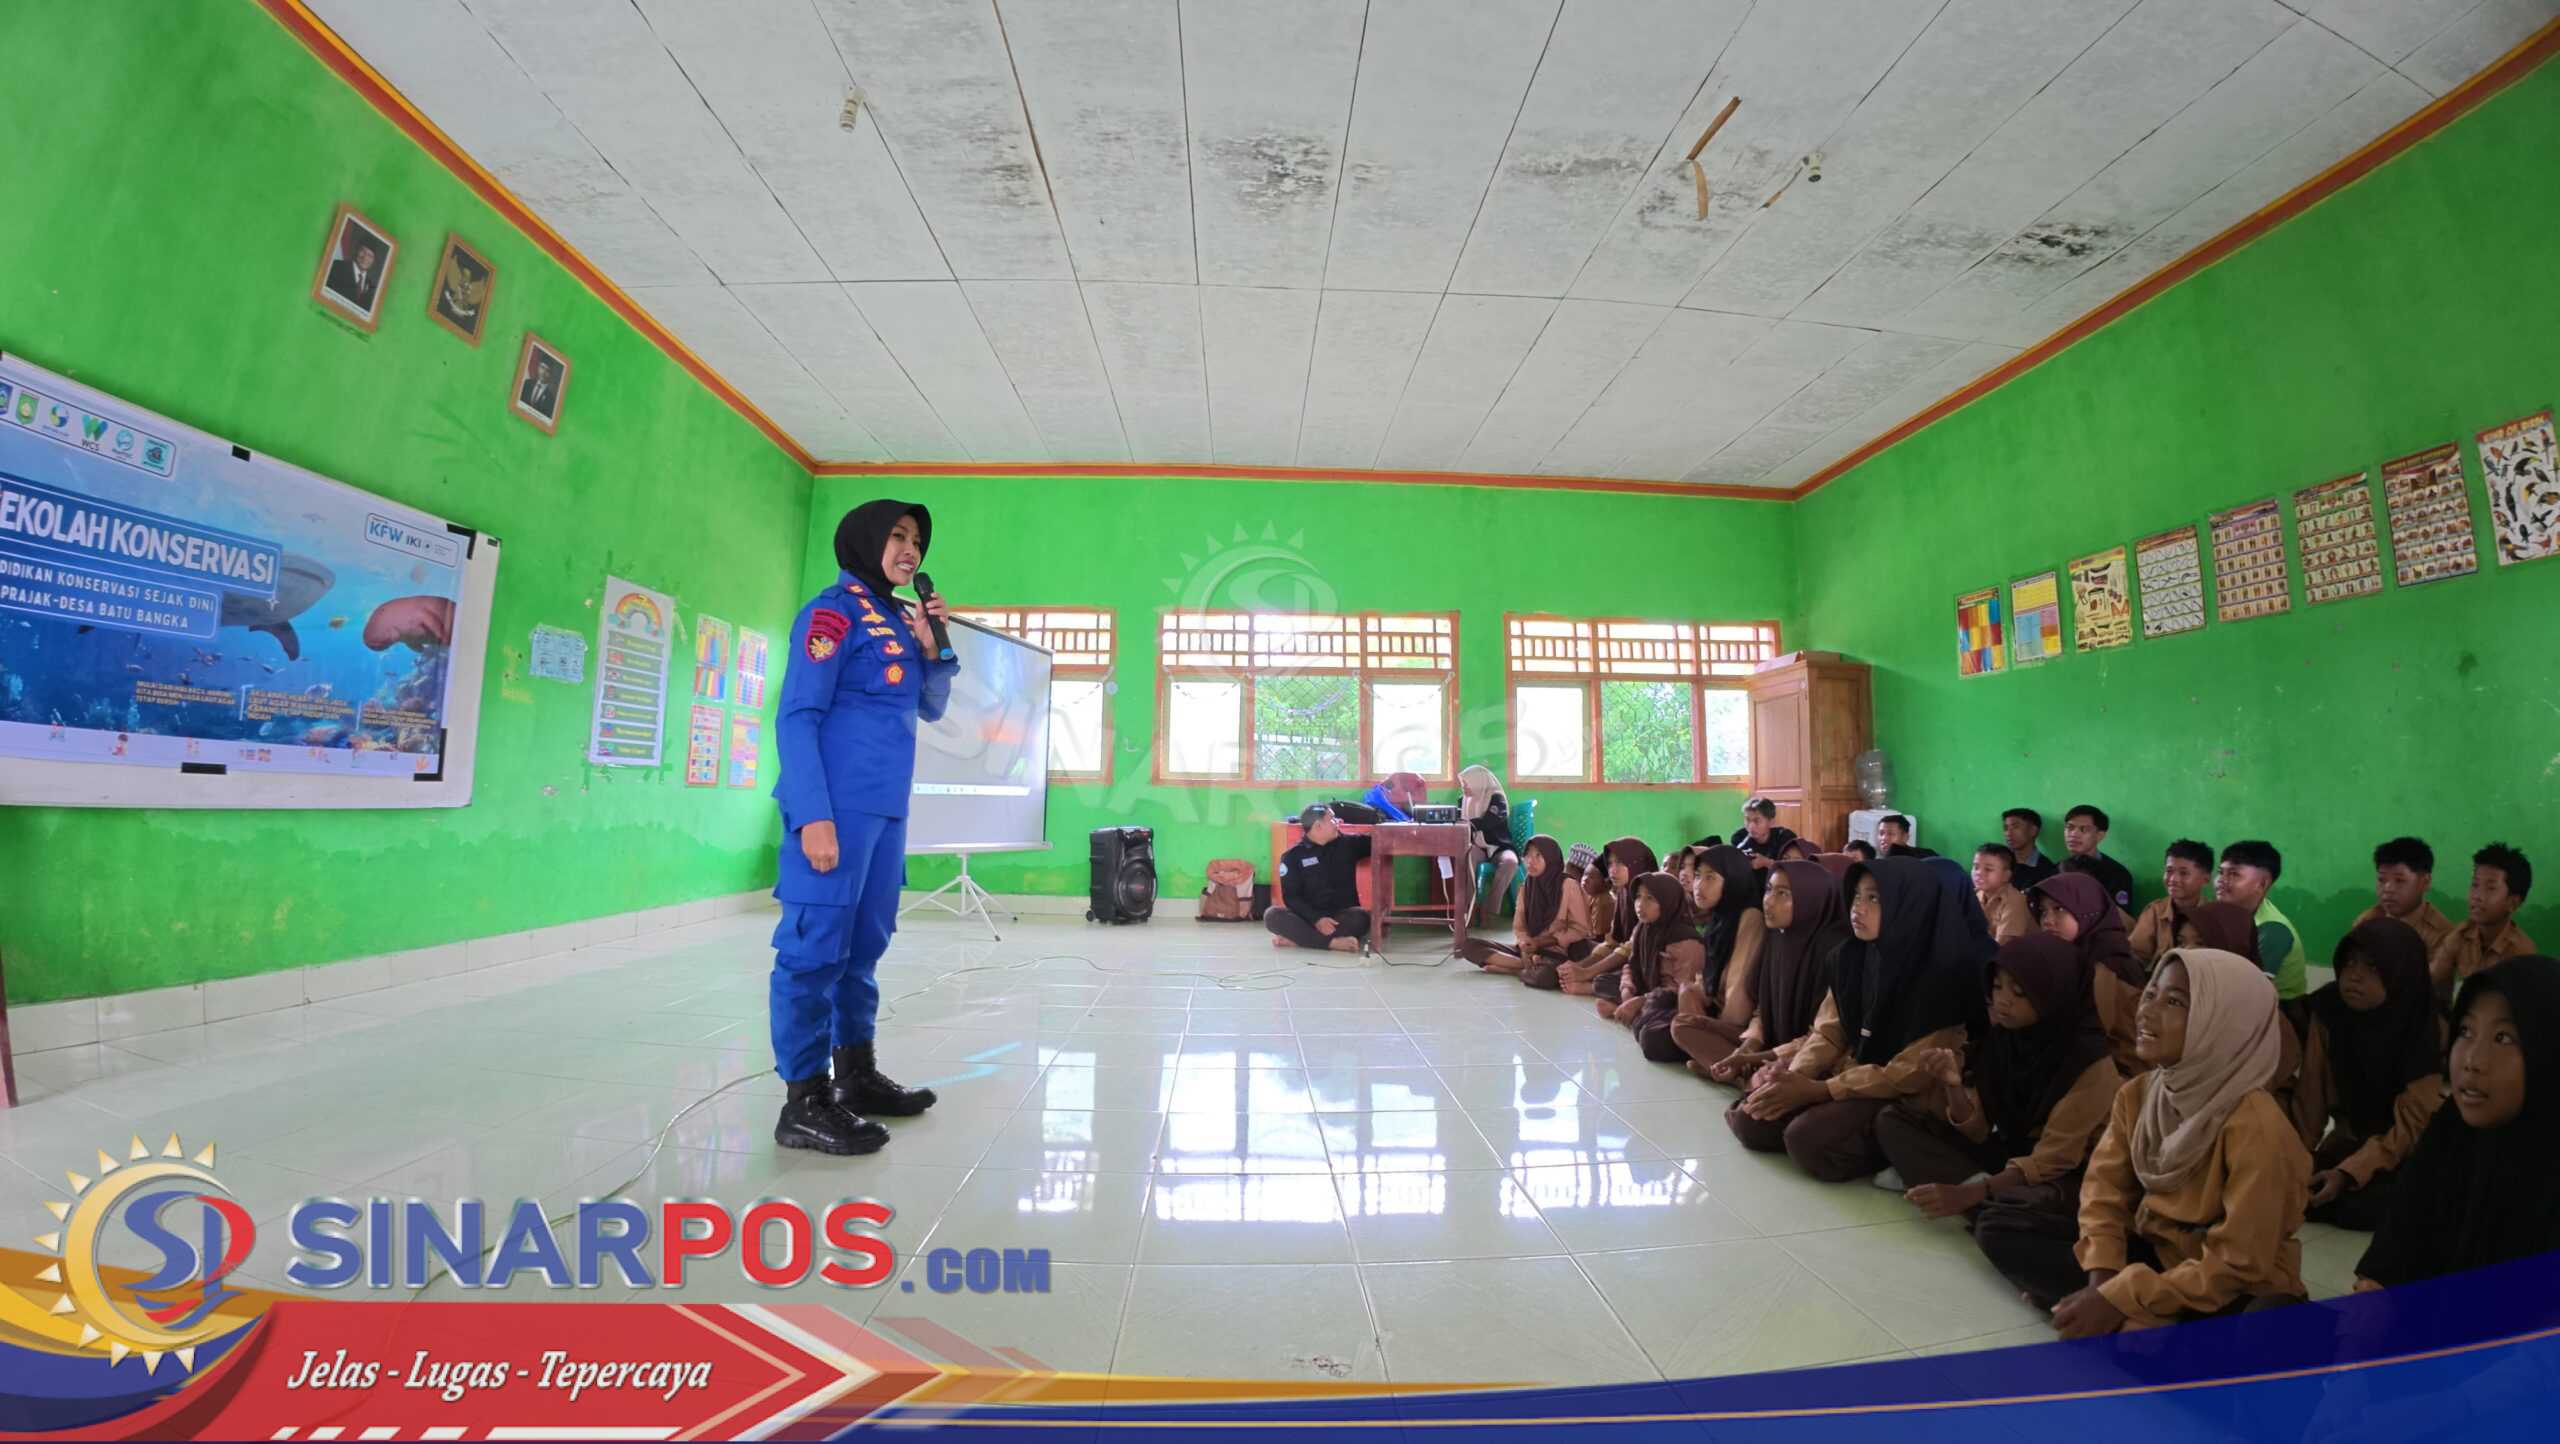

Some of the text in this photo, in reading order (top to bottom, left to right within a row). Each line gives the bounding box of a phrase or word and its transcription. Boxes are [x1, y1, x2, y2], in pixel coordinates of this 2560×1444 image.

[0, 490, 275, 585] EKOLAH KONSERVASI
[406, 535, 422, 548] IKI
[57, 571, 140, 599] KONSERVASI
[144, 588, 184, 608] SEJAK
[189, 597, 215, 613] DINI
[99, 602, 132, 621] BATU
[136, 608, 189, 629] BANGKA
